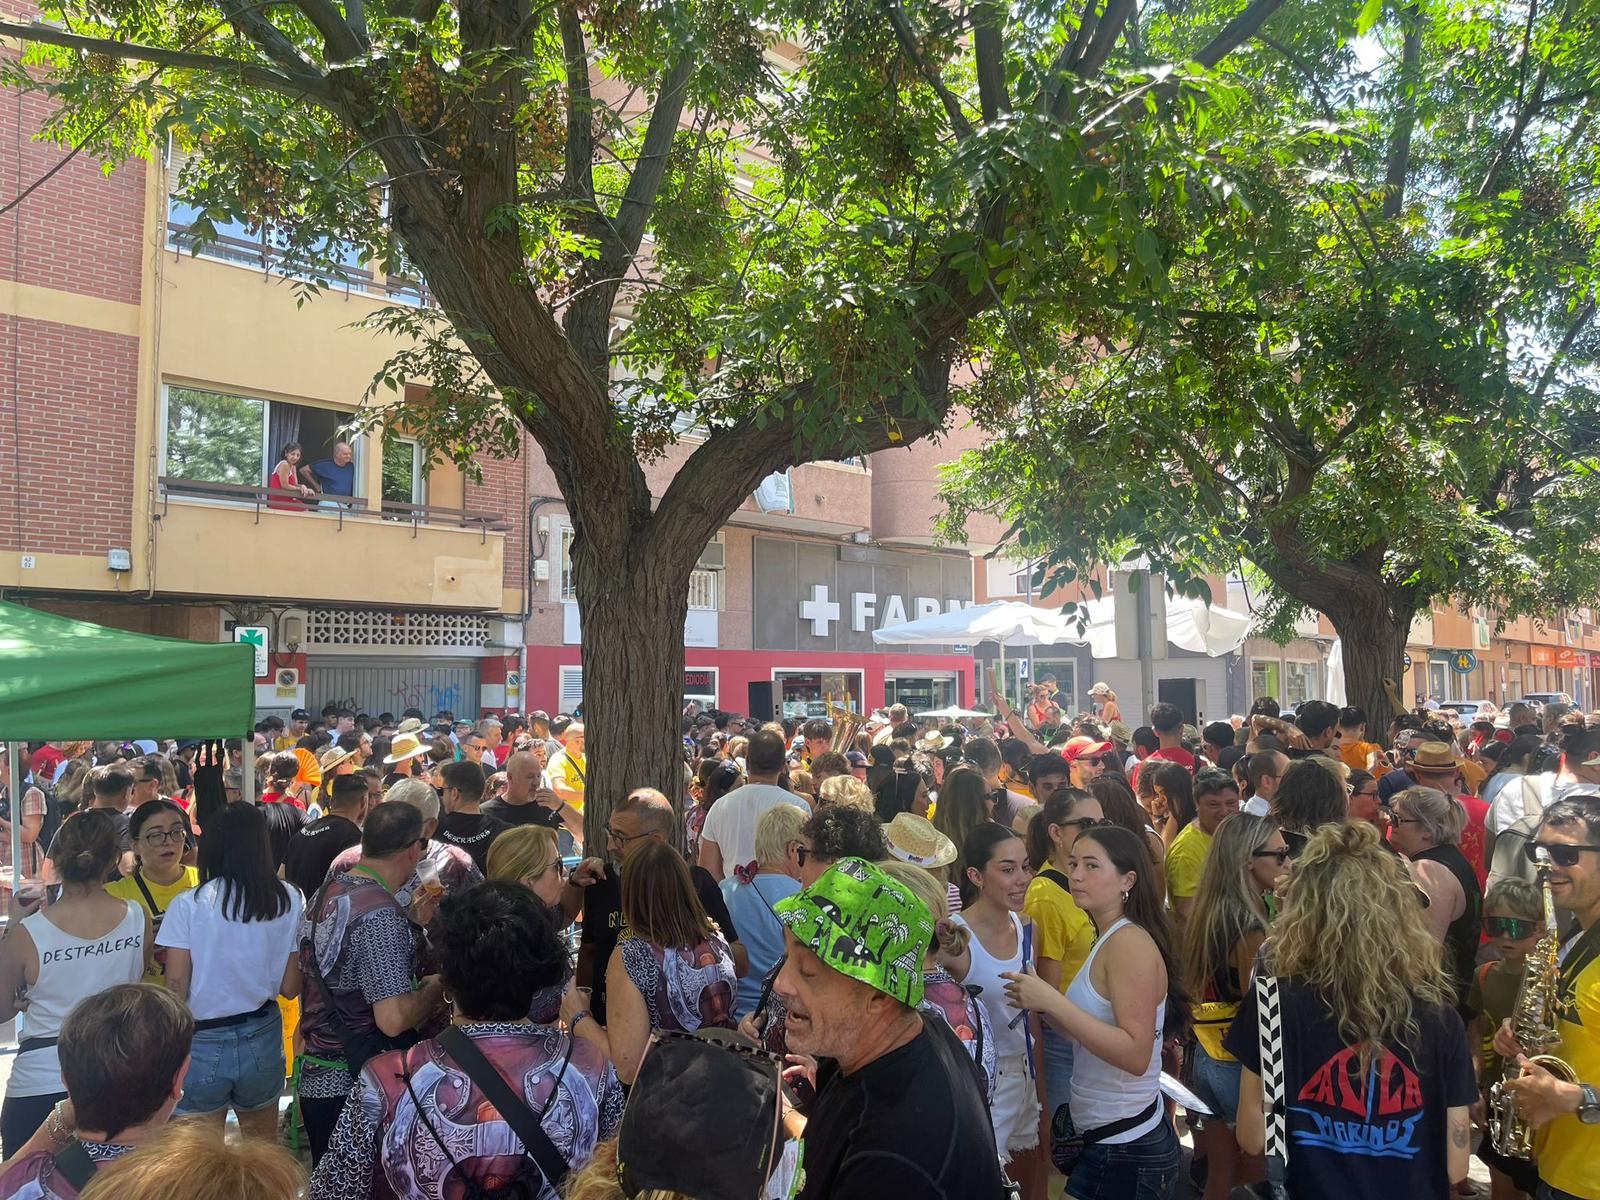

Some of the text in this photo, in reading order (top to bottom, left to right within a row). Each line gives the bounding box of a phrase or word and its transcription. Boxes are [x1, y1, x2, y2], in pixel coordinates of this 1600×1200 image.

[852, 592, 972, 632] FAR
[43, 935, 141, 965] DESTRALERS
[1309, 1110, 1424, 1152] MARINOS
